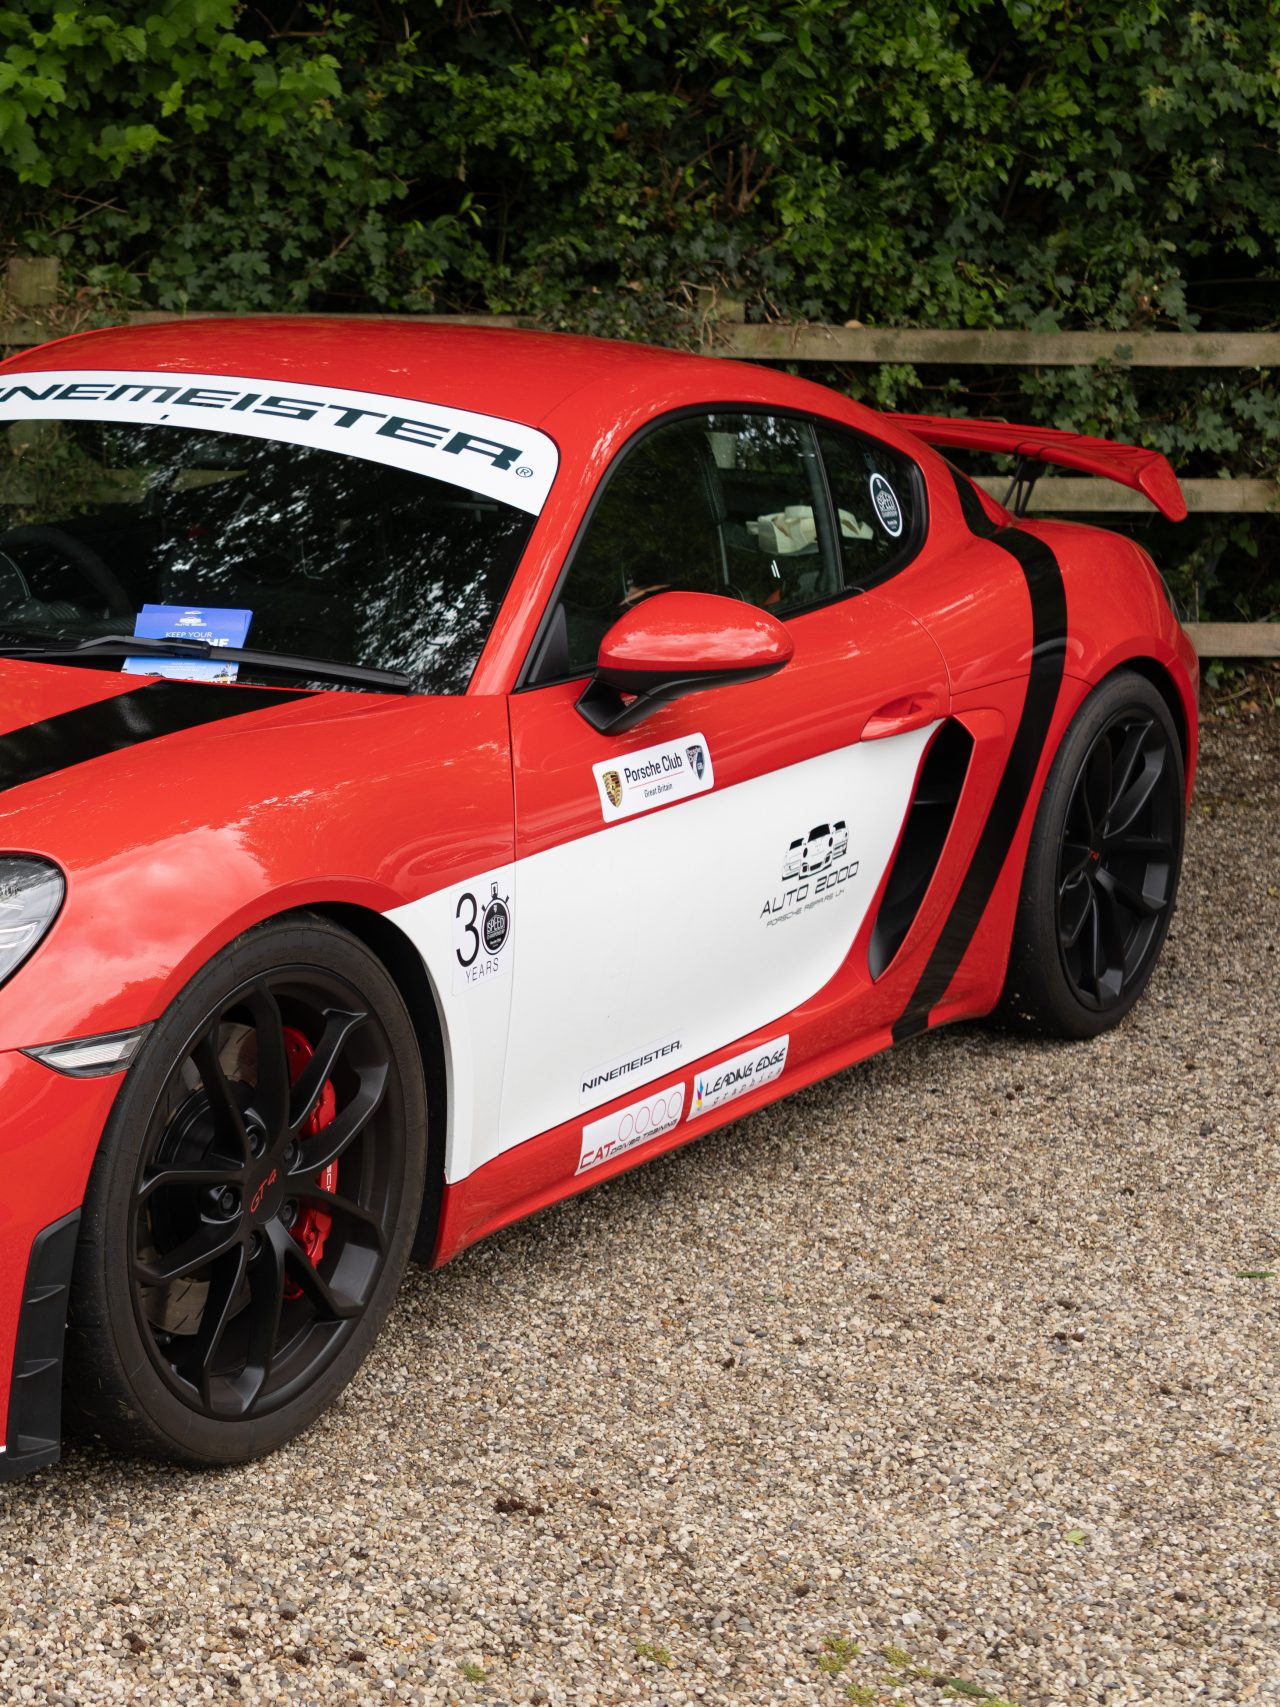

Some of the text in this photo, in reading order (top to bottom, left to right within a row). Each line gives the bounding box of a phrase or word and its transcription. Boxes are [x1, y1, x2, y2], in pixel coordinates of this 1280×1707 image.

[624, 752, 683, 784] Porsche Club
[644, 782, 673, 798] Great Britain
[760, 860, 859, 919] AUTO 2000
[465, 957, 499, 984] YEARS
[705, 1047, 786, 1097] LEADING EDGE
[580, 1140, 616, 1170] CAT
[250, 1168, 277, 1214] GT4
